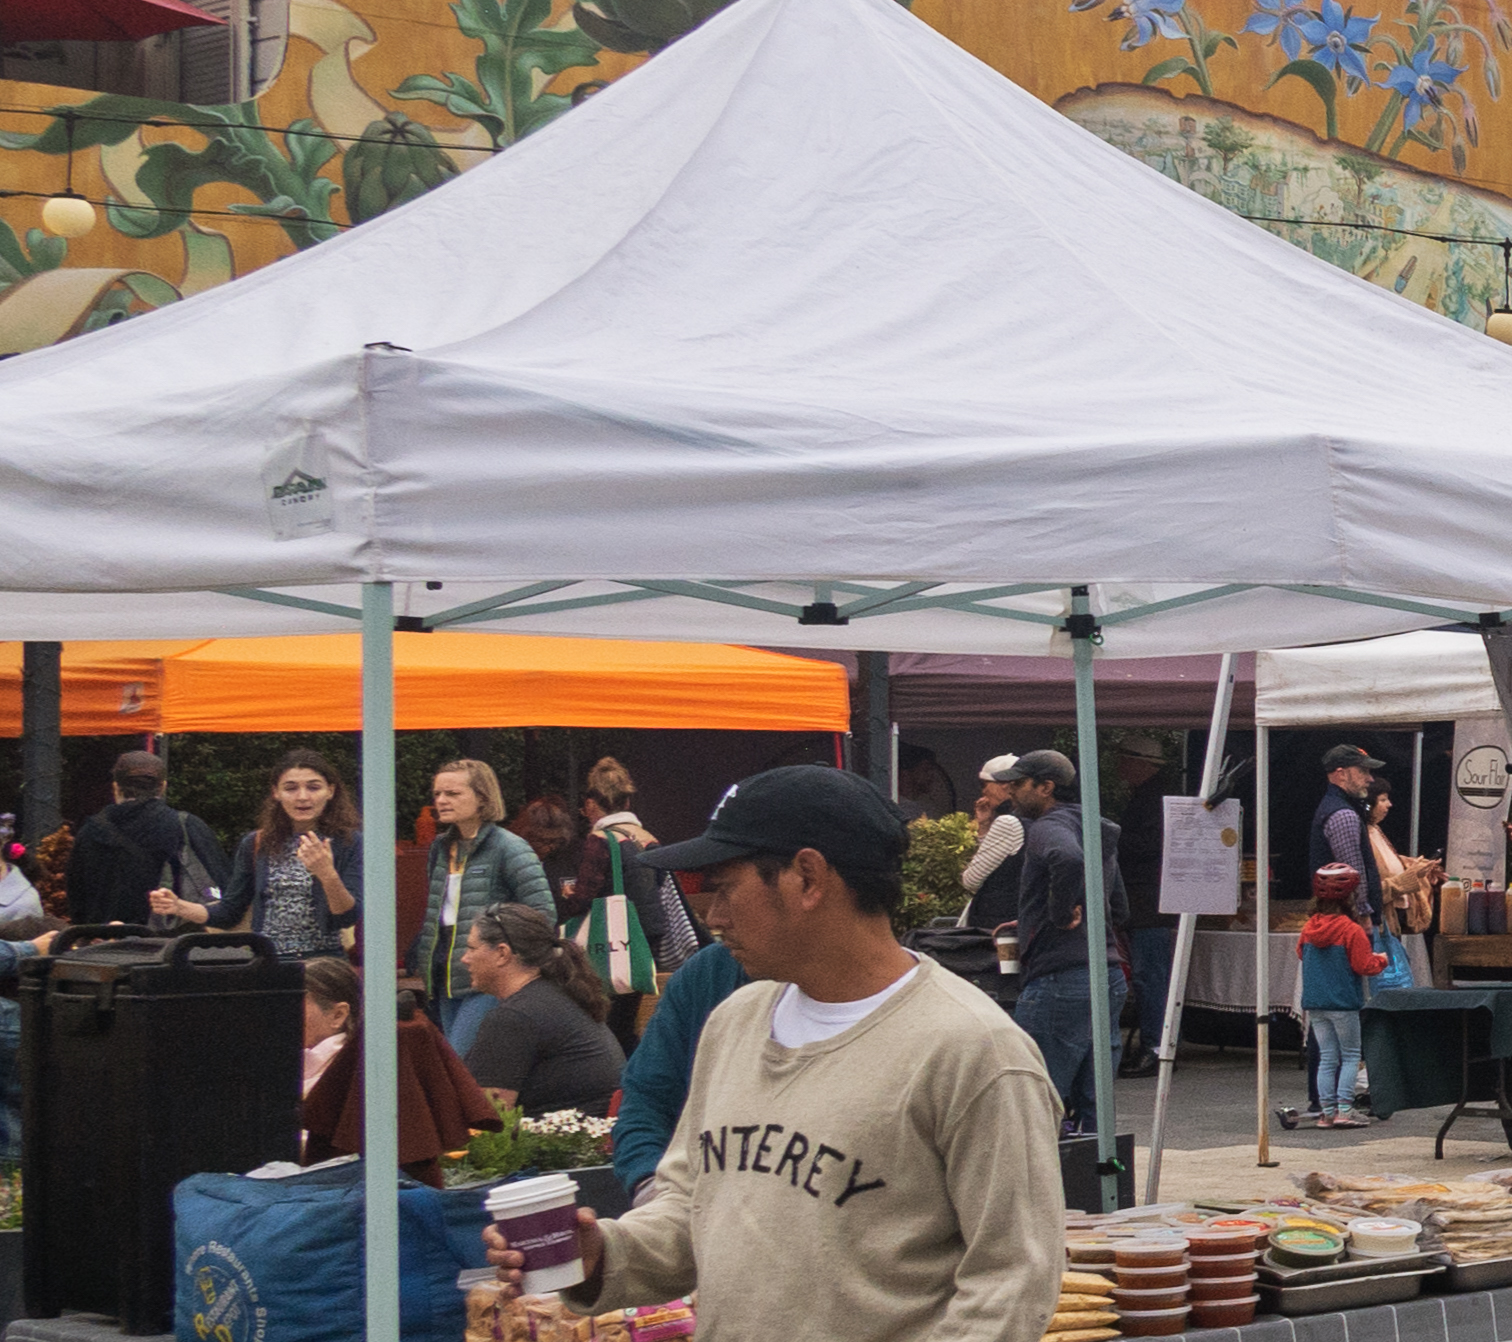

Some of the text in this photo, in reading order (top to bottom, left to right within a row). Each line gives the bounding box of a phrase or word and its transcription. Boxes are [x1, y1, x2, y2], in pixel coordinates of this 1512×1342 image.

[1463, 760, 1487, 786] Sour
[587, 939, 631, 956] RLY
[699, 1123, 887, 1209] NTEREY
